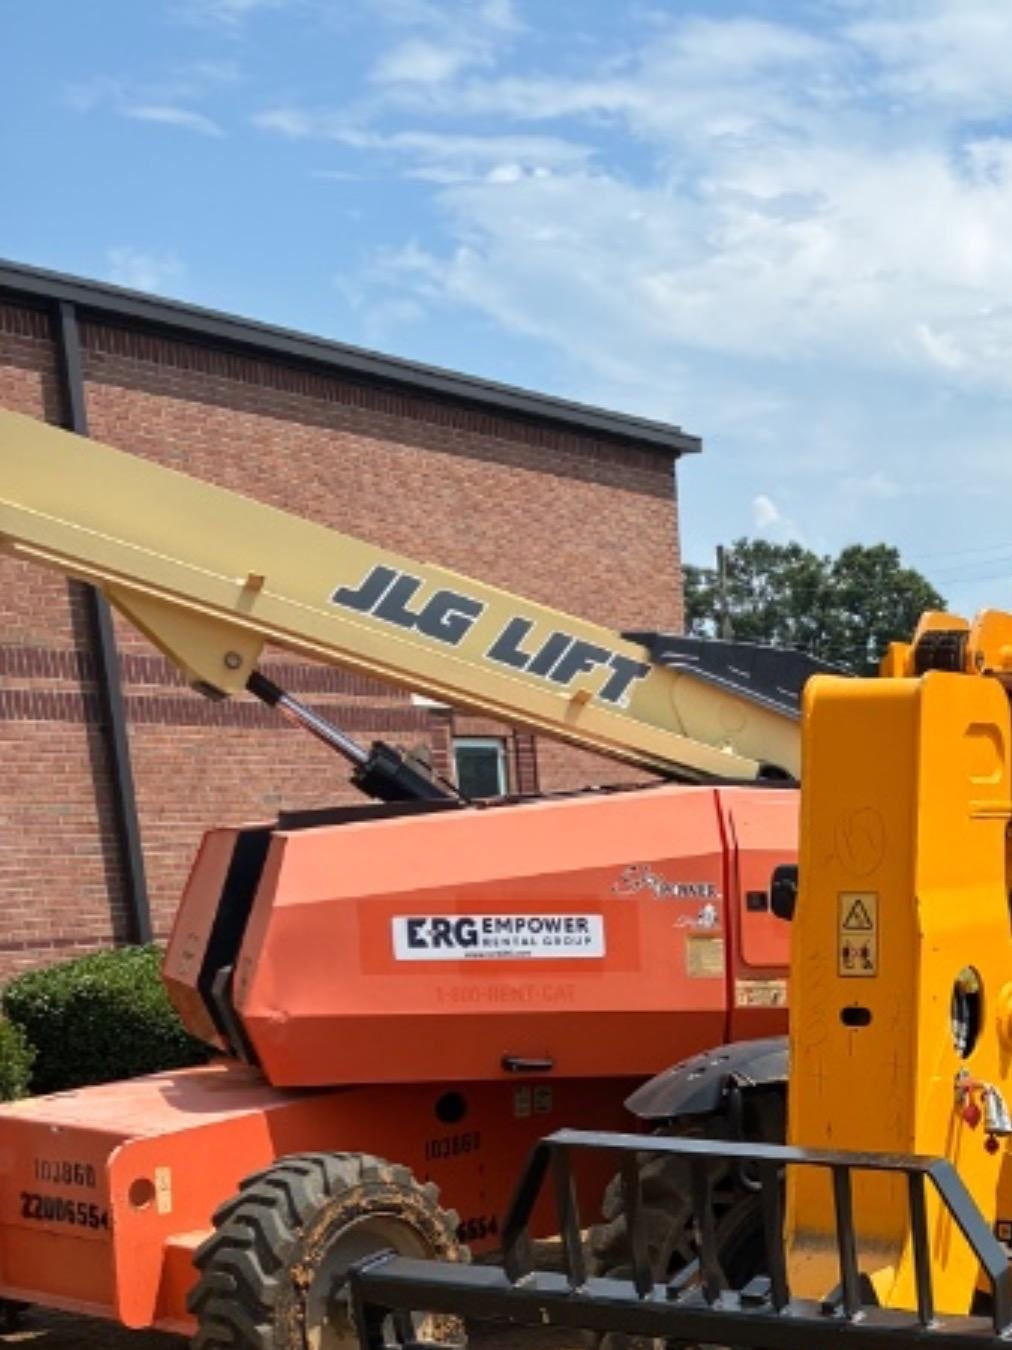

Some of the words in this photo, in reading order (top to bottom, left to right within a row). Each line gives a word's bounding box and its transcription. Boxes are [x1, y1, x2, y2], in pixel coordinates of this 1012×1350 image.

[332, 565, 486, 645] JLG
[485, 616, 651, 703] LIFT
[407, 917, 478, 948] ERG
[481, 917, 590, 934] EMPOWER
[542, 936, 592, 946] GROUP
